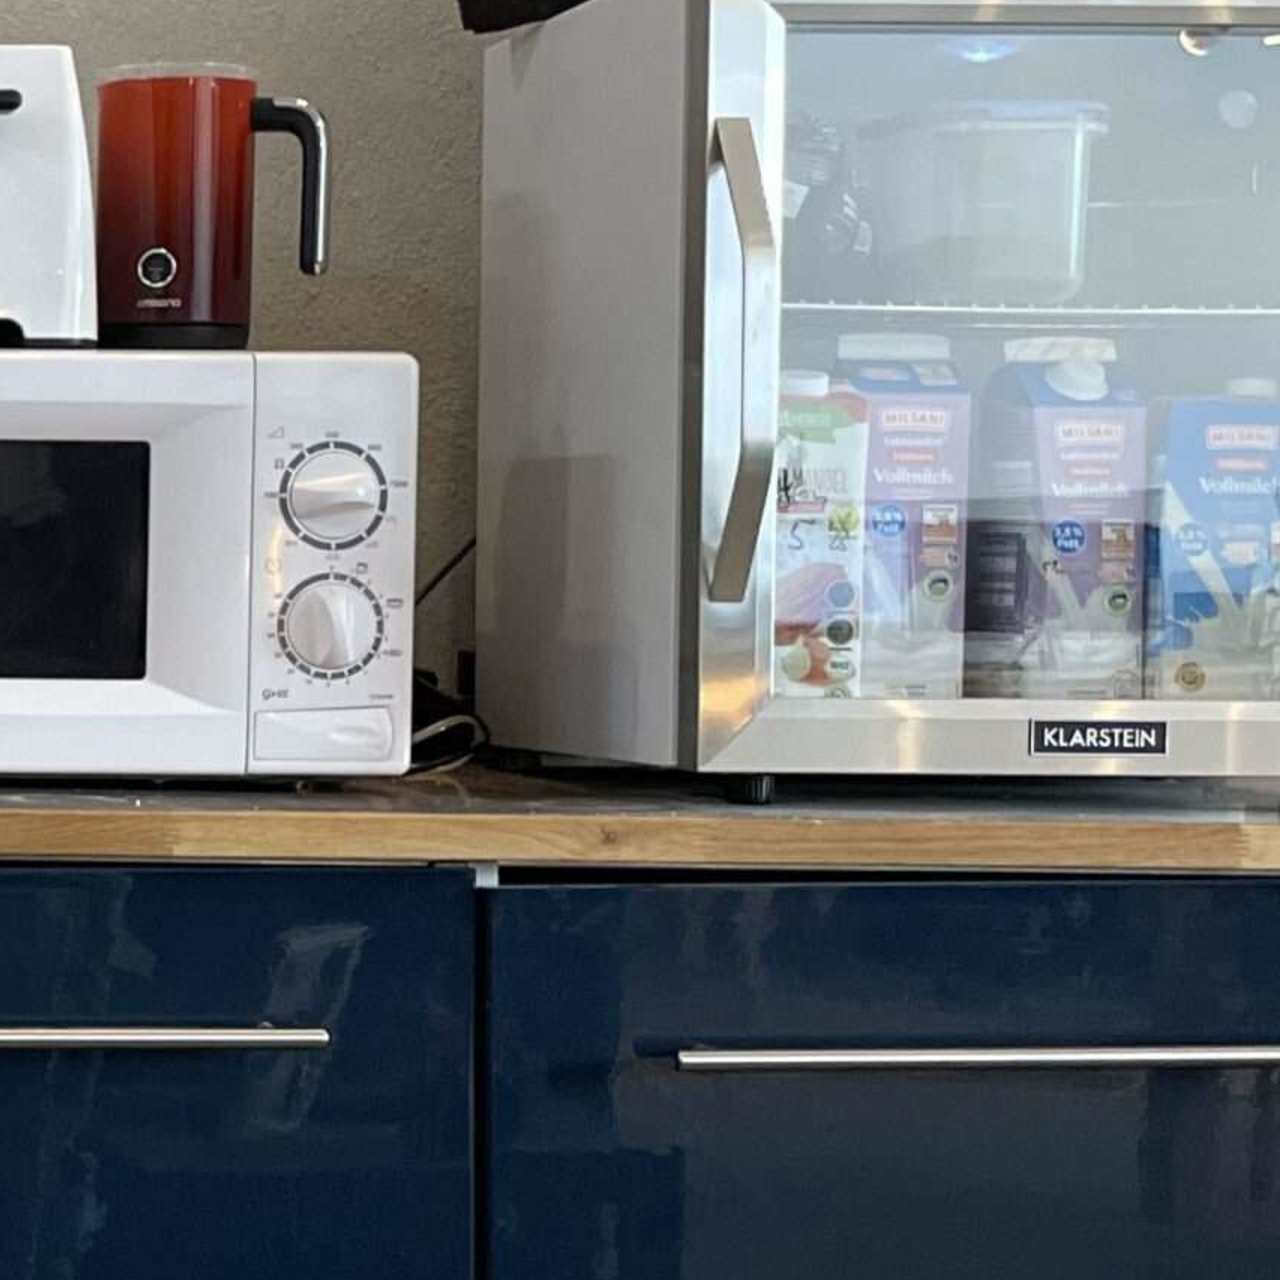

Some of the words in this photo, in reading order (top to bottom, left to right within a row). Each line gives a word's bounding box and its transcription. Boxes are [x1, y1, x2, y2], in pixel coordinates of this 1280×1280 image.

[885, 411, 945, 425] MILSANI
[873, 468, 954, 485] Vollmilch
[1042, 727, 1157, 749] KLARSTEIN
